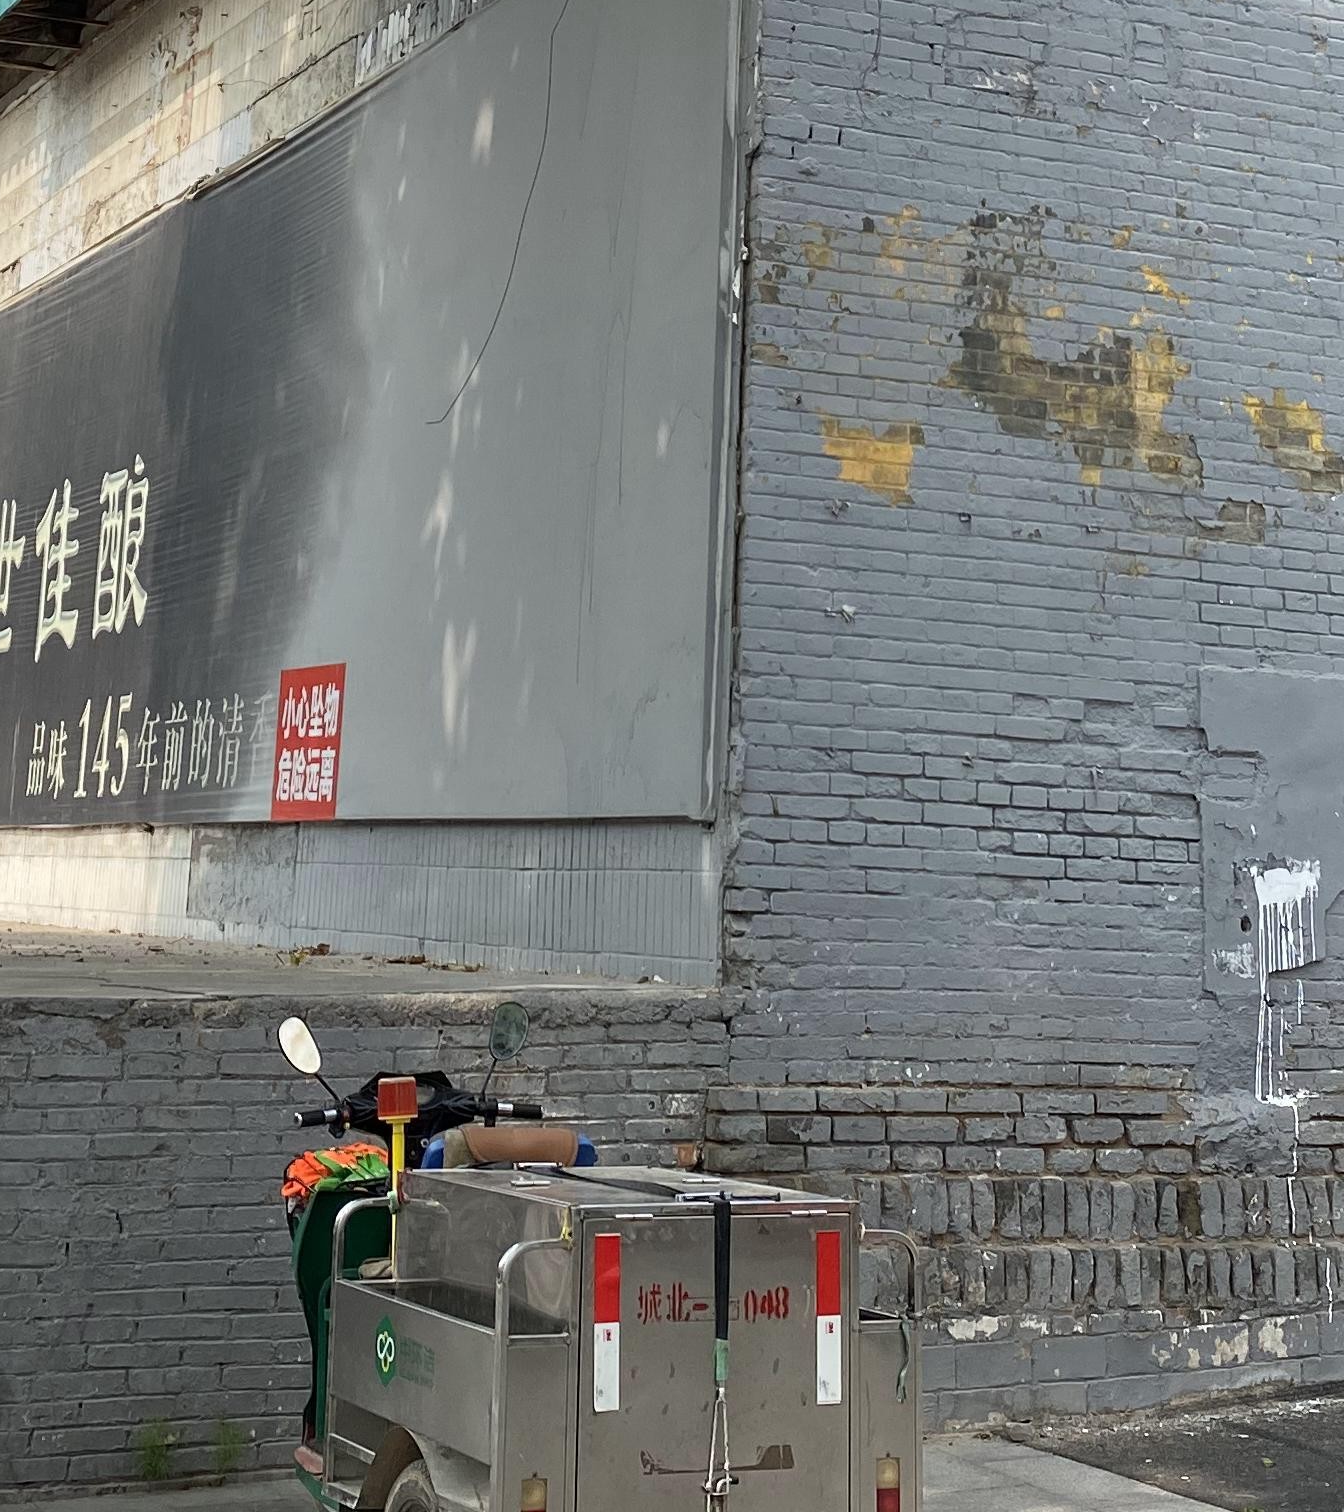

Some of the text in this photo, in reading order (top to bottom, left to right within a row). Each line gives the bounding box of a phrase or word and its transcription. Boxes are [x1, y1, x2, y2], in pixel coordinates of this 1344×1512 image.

[281, 683, 340, 739] 小心坠物
[276, 747, 336, 802] 危险远离
